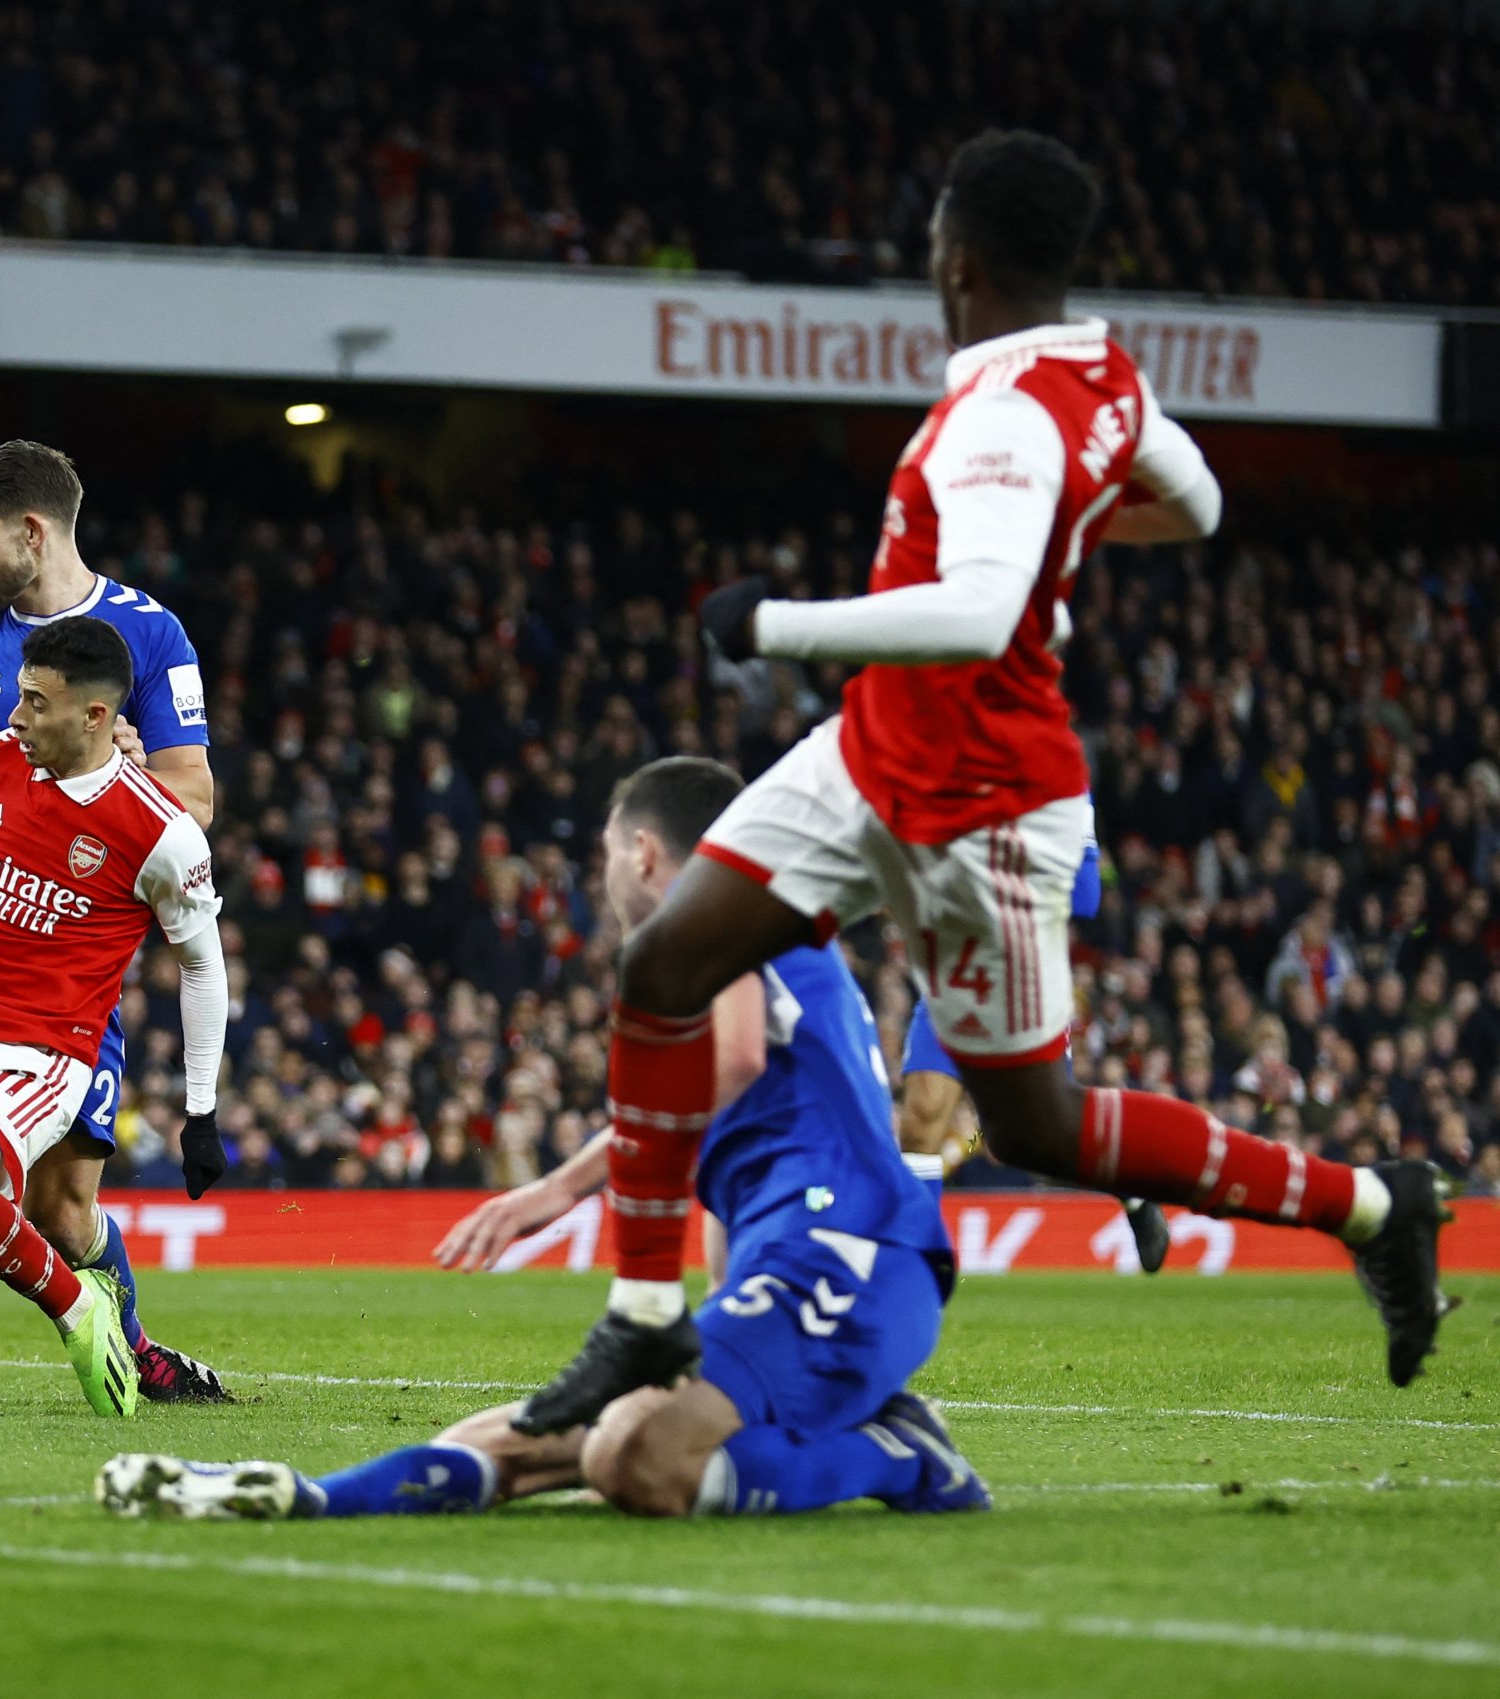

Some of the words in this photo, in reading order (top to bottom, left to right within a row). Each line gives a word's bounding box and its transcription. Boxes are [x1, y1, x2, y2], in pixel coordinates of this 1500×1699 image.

[654, 299, 955, 389] Emirate
[1107, 318, 1262, 402] ETTER
[920, 928, 995, 1005] 14
[90, 1069, 116, 1126] 2
[719, 1273, 790, 1316] 5
